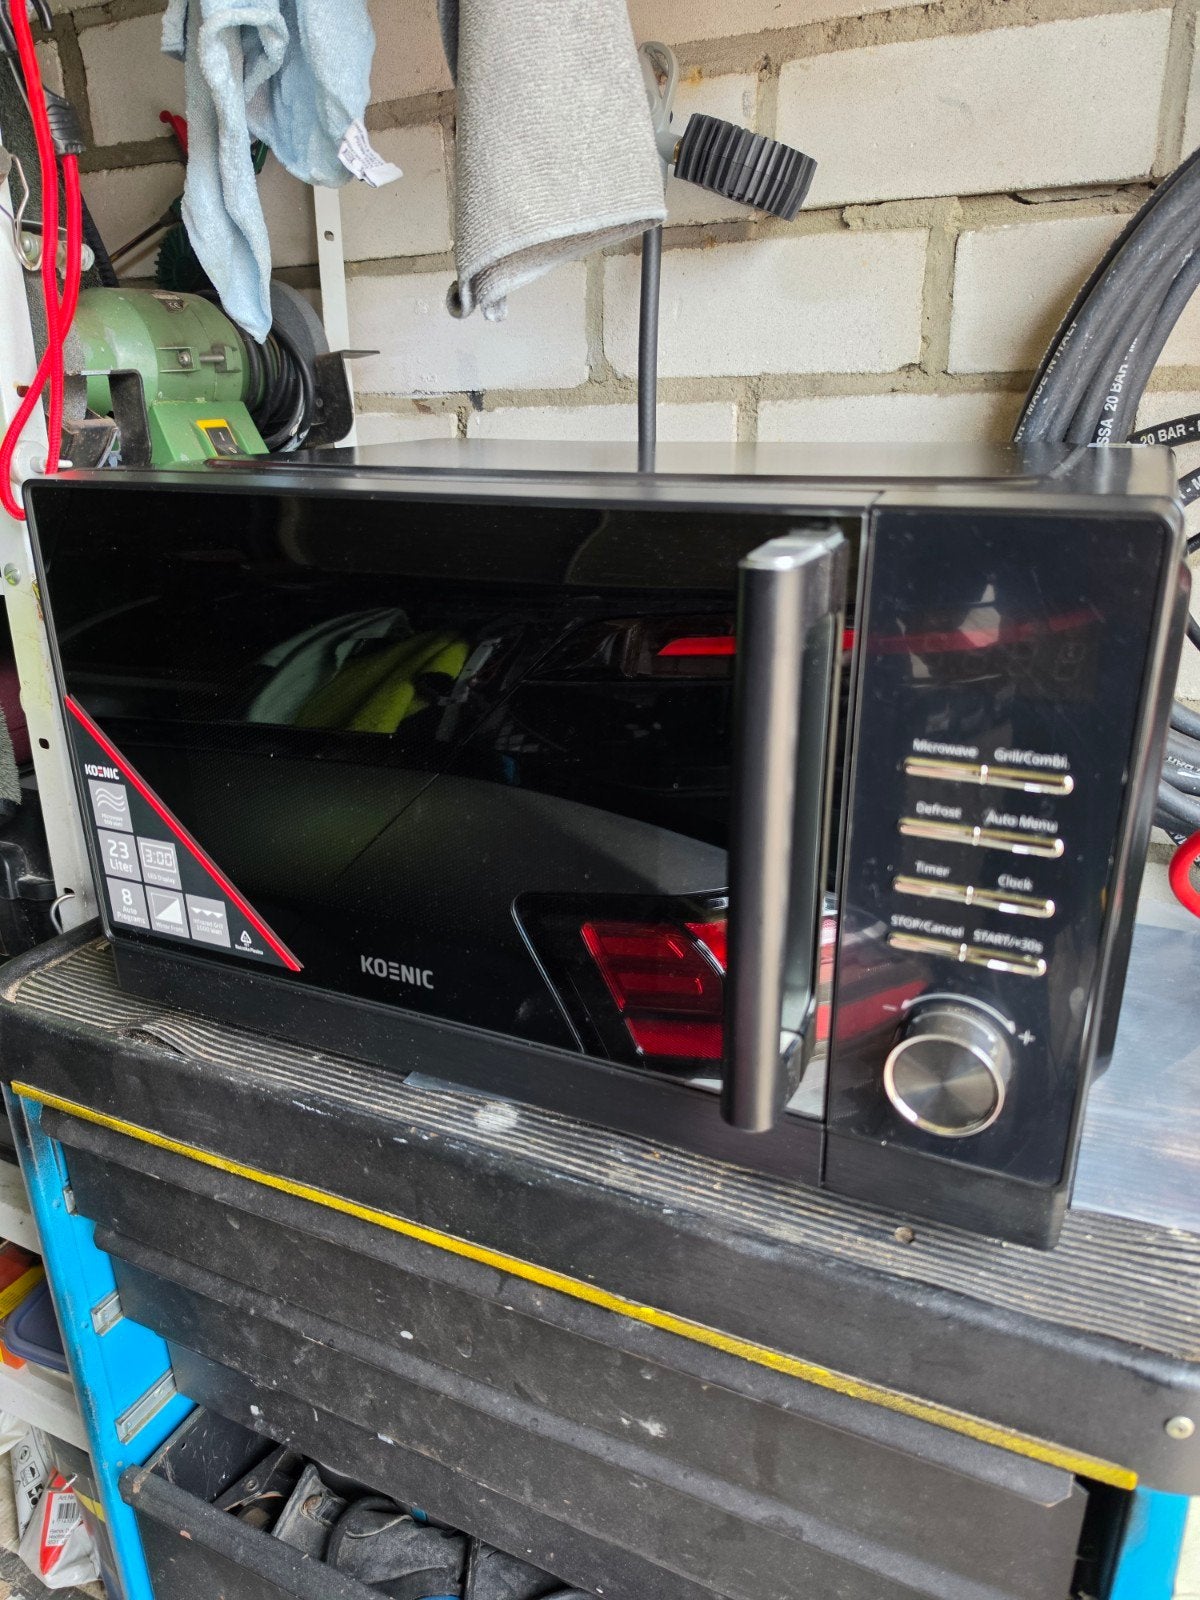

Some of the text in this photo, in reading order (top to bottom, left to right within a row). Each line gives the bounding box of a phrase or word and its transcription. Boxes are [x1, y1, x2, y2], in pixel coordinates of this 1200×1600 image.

[1104, 395, 1119, 412] 20
[1157, 423, 1187, 442] BAR
[912, 738, 979, 759] Microwave
[994, 746, 1070, 770] Grill/Combi
[84, 763, 120, 780] KOENIC
[915, 801, 962, 819] Defrost
[985, 809, 1058, 834] Auto Menu
[107, 839, 130, 860] 23
[145, 848, 173, 867] 3:00
[109, 858, 133, 873] Liter
[915, 860, 950, 878] Timer
[997, 873, 1033, 892] Clock
[121, 888, 133, 906] 8
[116, 910, 146, 925] Programs
[122, 905, 138, 916] Auto
[890, 914, 965, 939] STOP/Cancel
[360, 954, 434, 990] KOENIC
